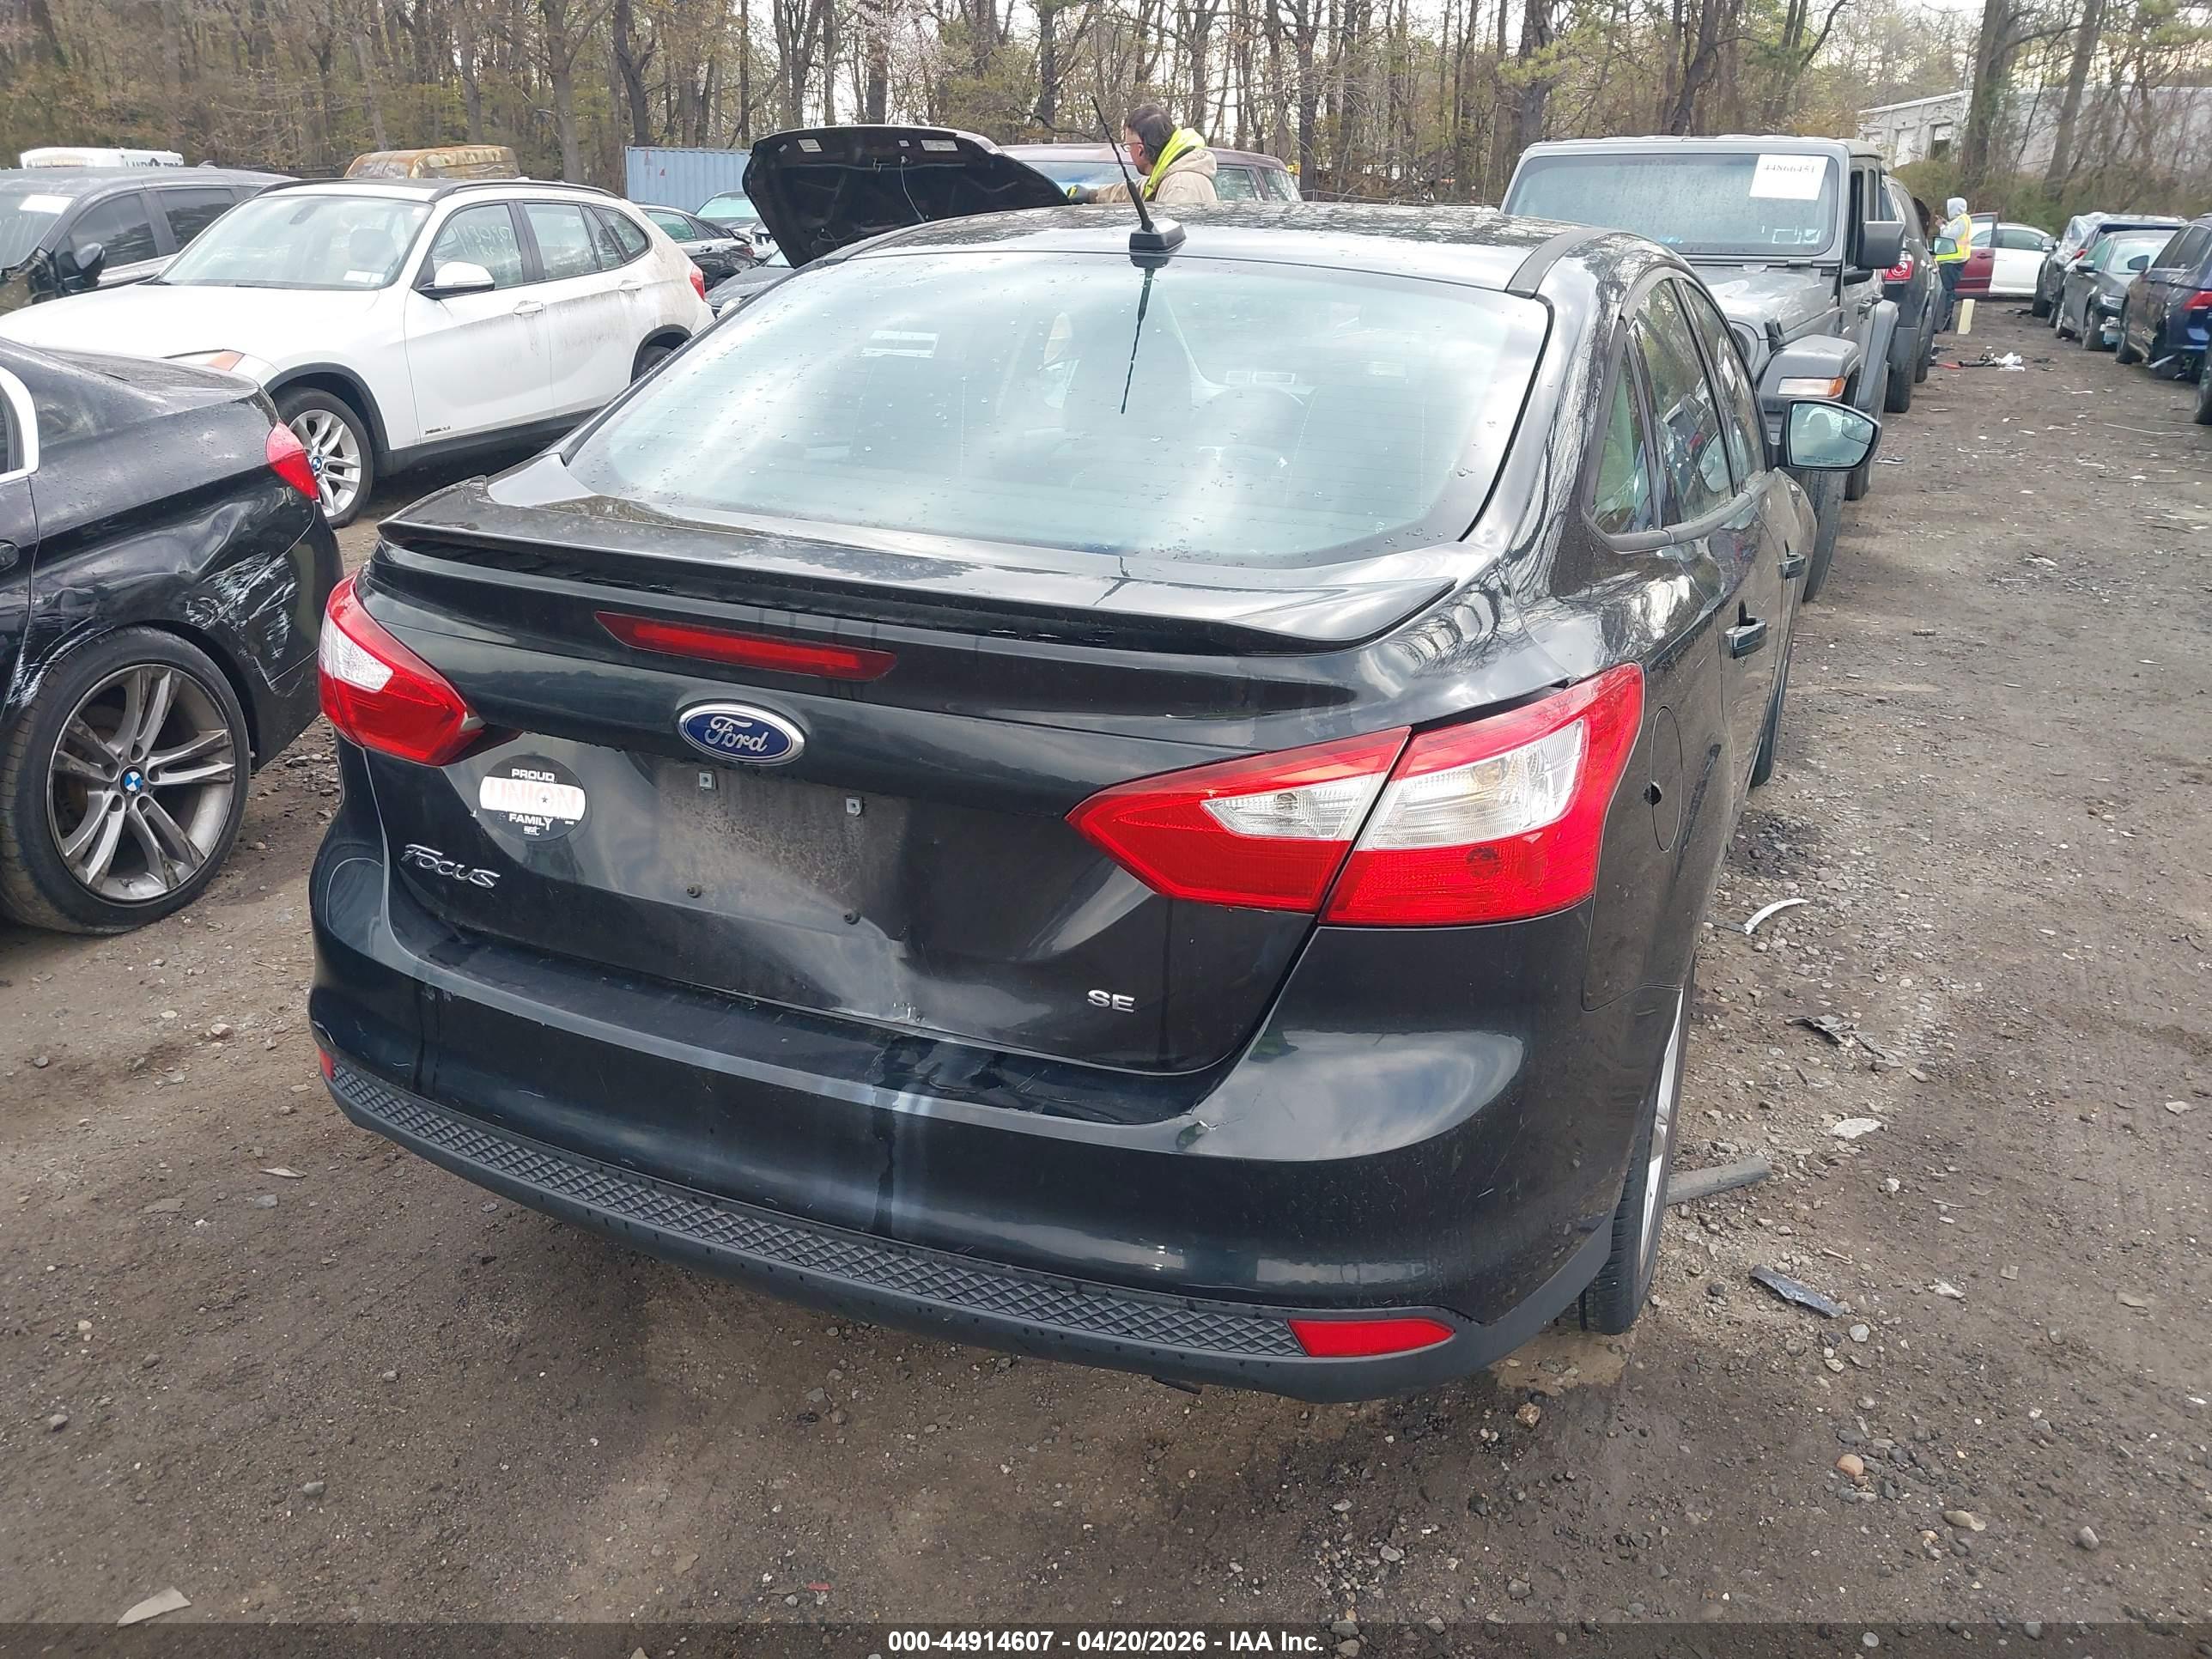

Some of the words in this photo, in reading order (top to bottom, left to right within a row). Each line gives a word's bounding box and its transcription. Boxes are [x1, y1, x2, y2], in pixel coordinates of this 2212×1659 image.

[704, 716, 769, 752] Ford
[511, 768, 556, 782] PROUD
[488, 779, 579, 814] UNION
[508, 812, 554, 831] FAMILY
[1087, 990, 1135, 1013] SE
